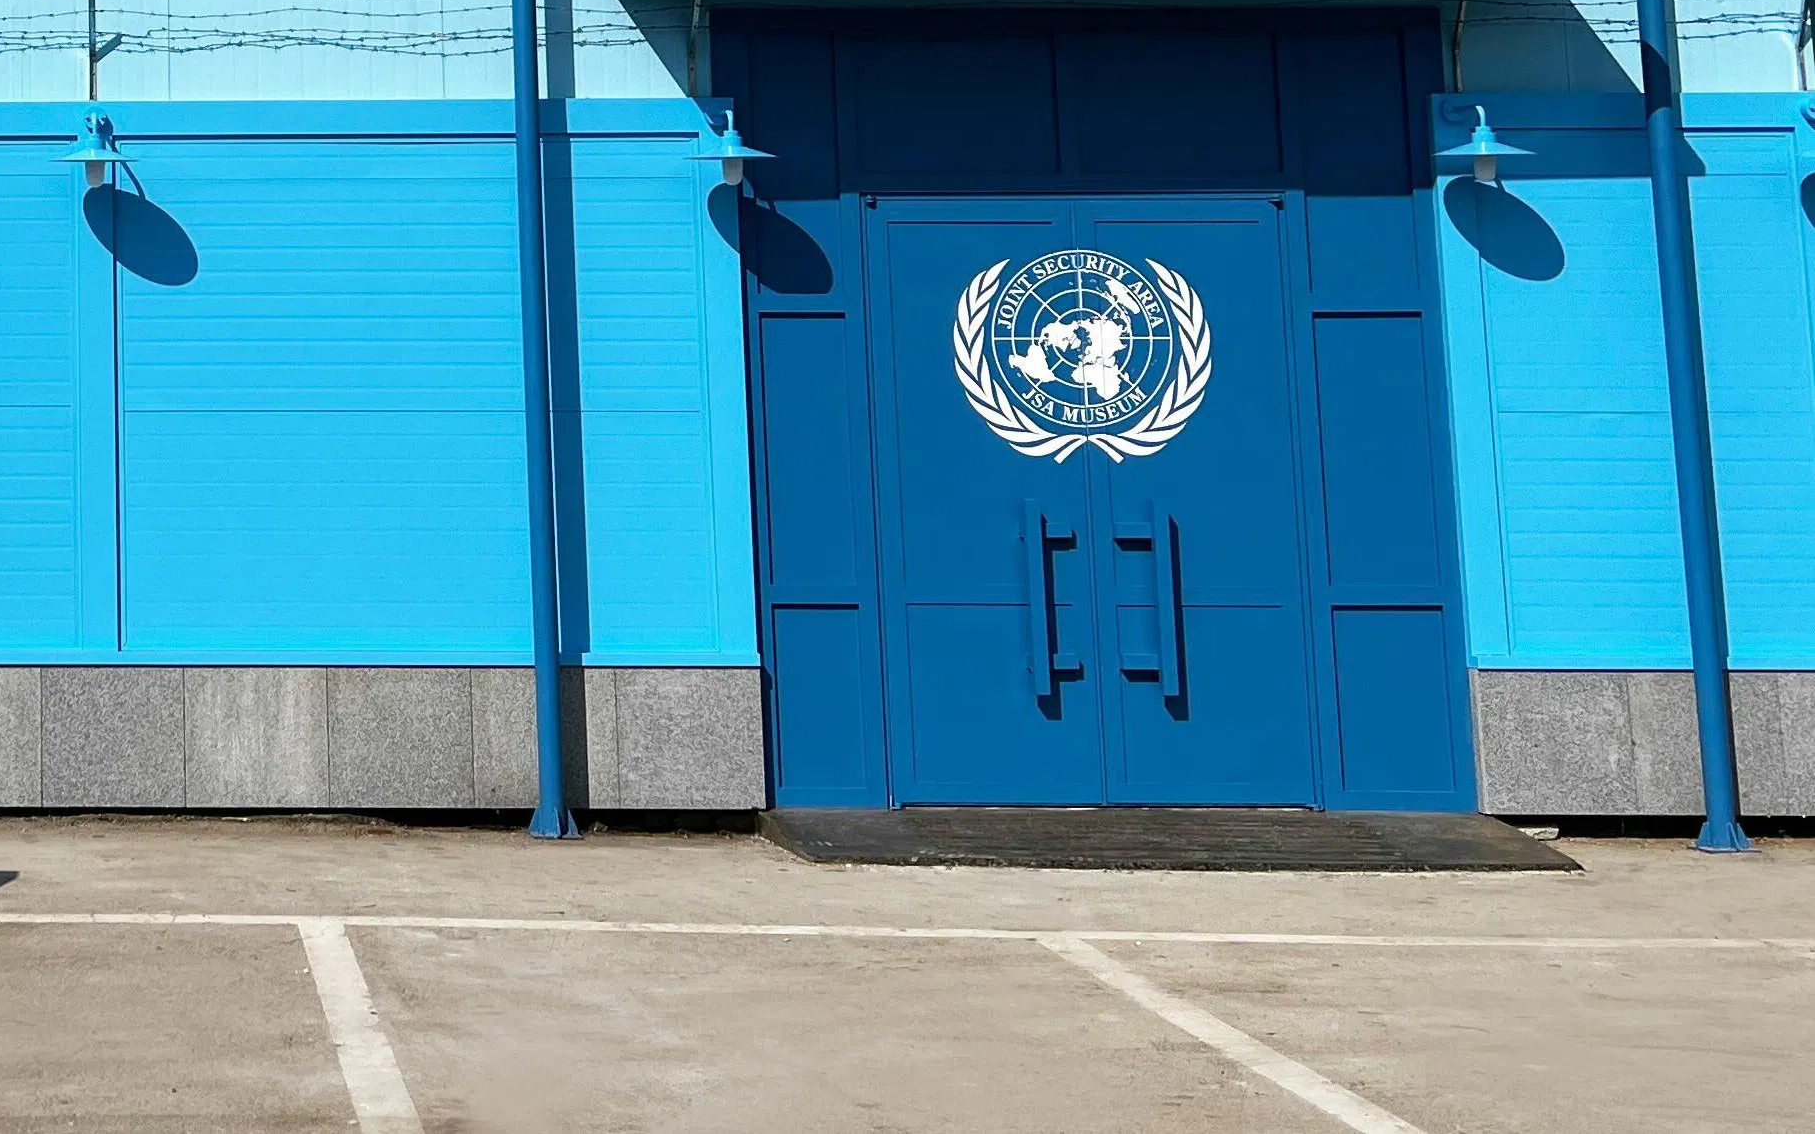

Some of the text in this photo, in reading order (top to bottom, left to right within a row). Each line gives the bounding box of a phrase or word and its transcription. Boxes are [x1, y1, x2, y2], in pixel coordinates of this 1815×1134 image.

[997, 253, 1164, 330] JOINT SECURITY AREA
[1021, 386, 1149, 423] JSA MUSEUM
